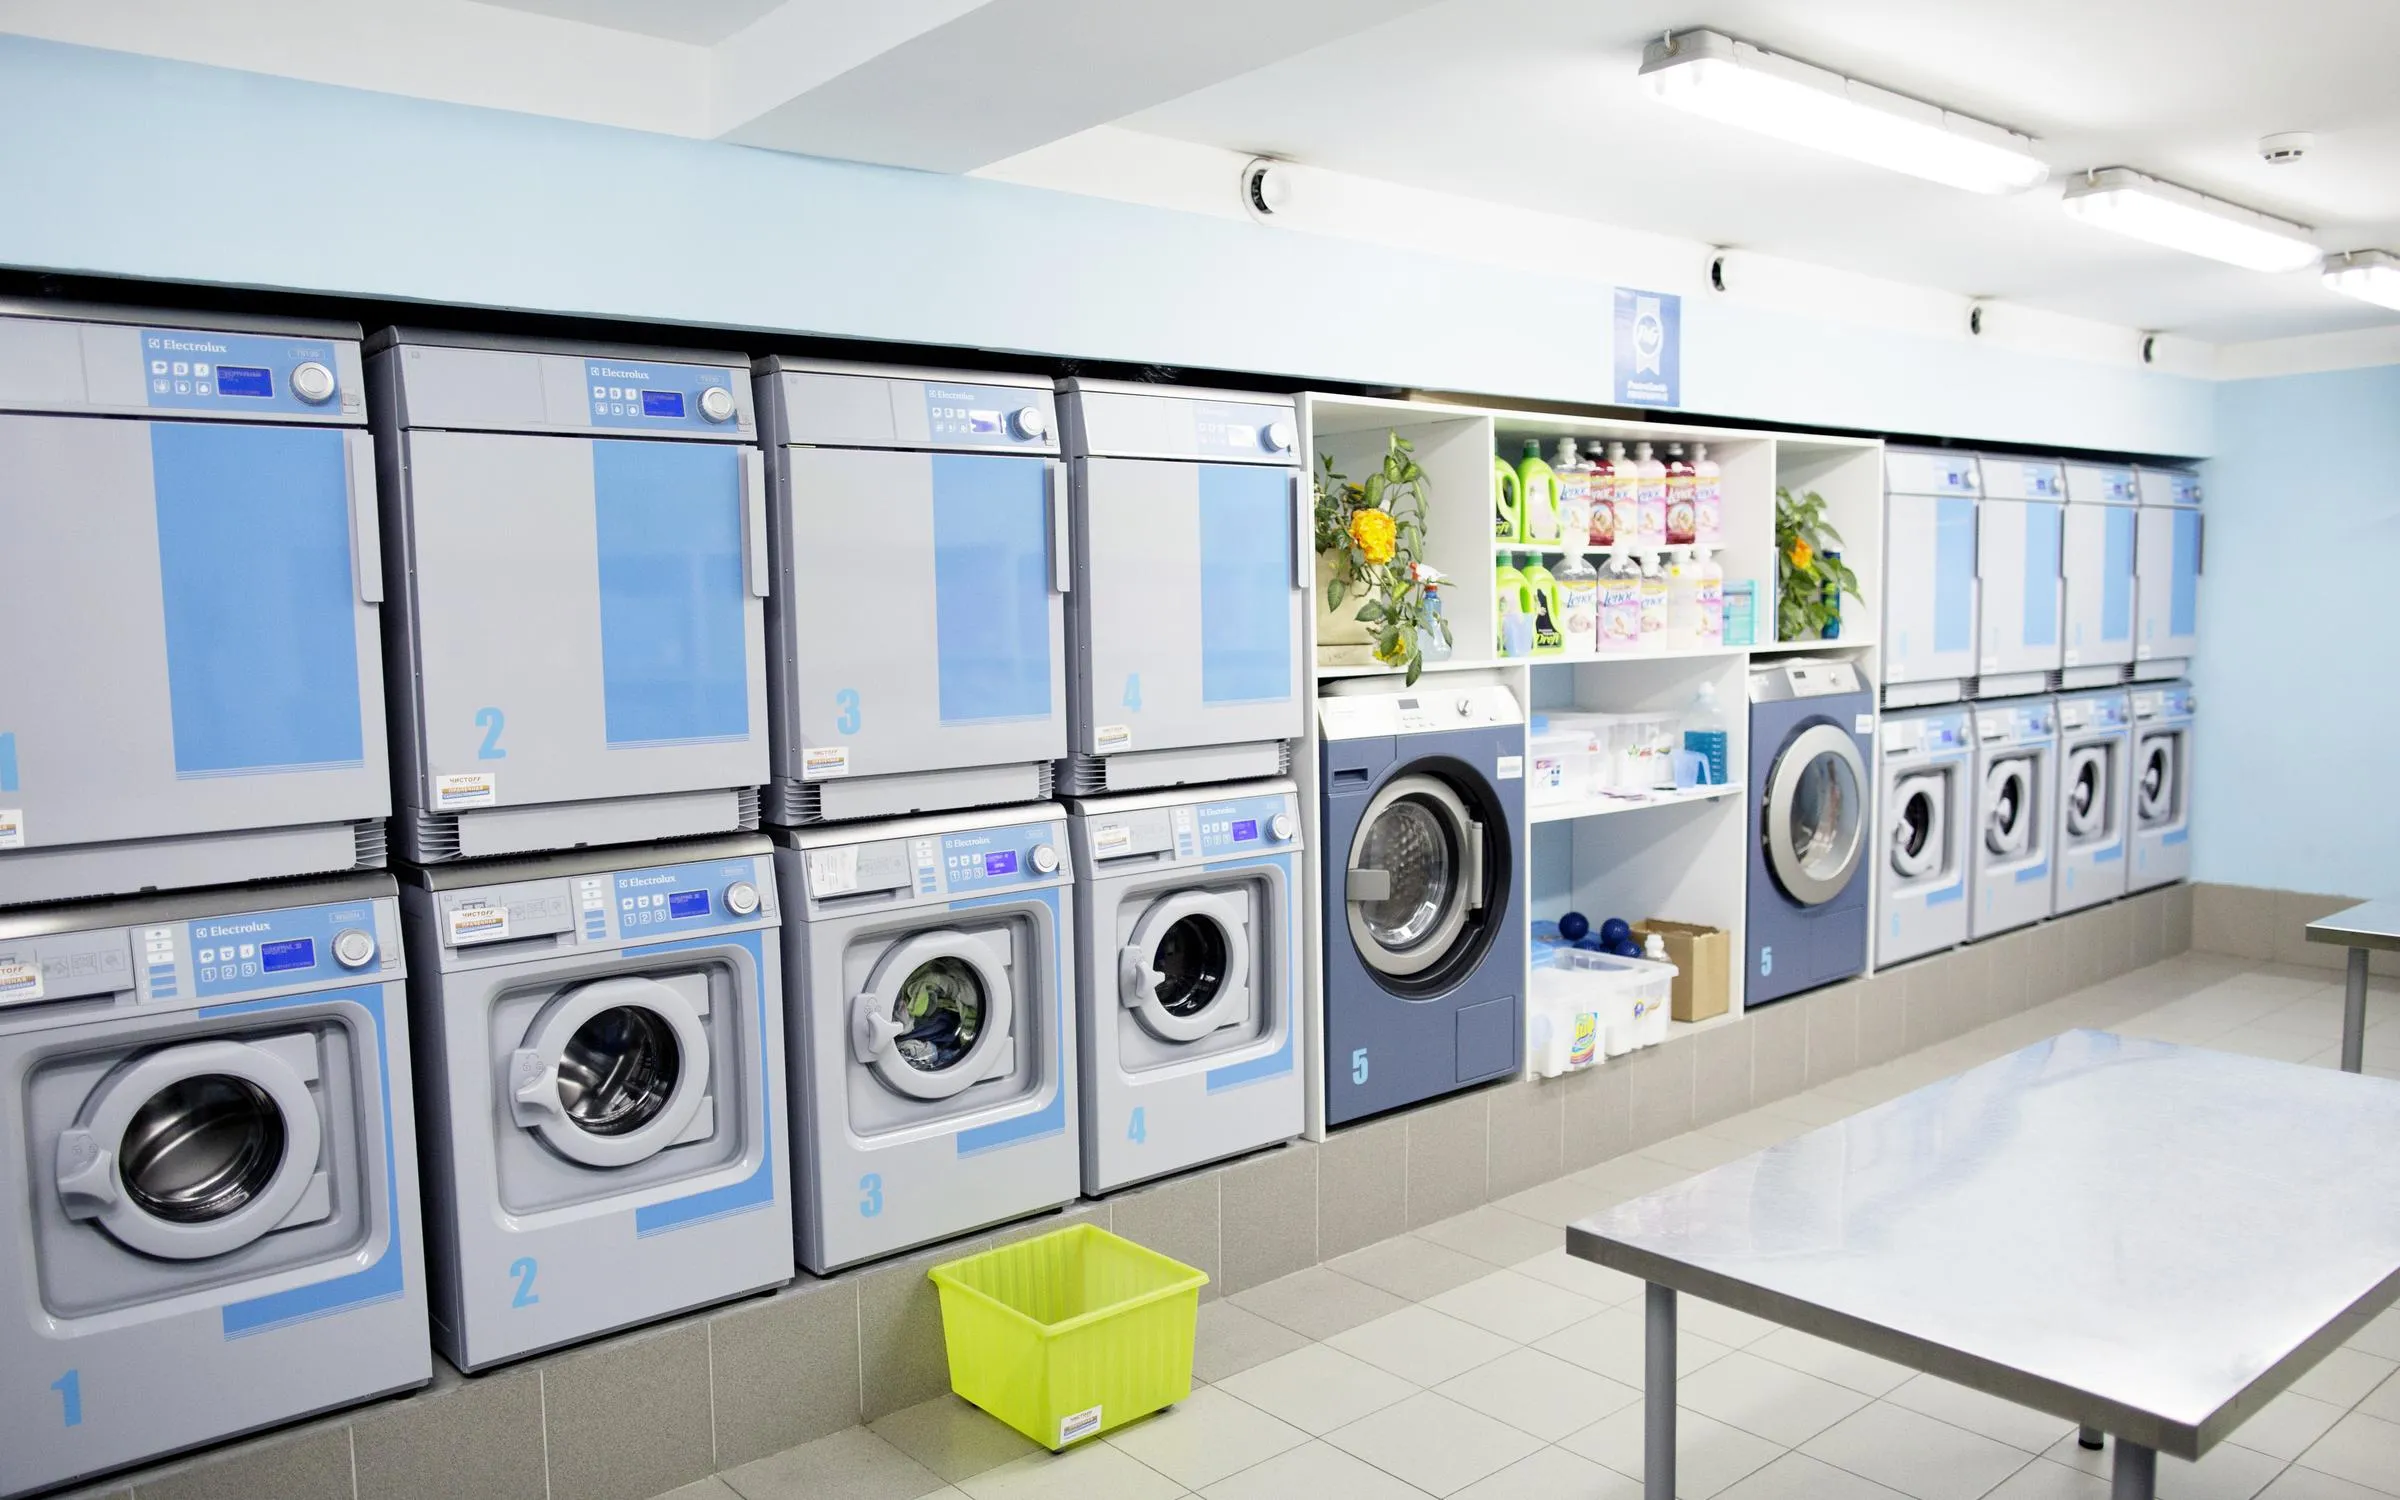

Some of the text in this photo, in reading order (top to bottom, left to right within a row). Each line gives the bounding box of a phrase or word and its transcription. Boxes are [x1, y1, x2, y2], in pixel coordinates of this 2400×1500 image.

[164, 339, 227, 353] Electrolux
[602, 369, 649, 380] Electrolux
[1123, 672, 1142, 713] 4
[836, 688, 861, 735] 3
[475, 706, 507, 760] 2
[954, 837, 991, 848] Electrolux
[630, 874, 677, 888] Electrolux
[211, 921, 271, 937] Electrolux
[627, 914, 634, 924] 1
[642, 913, 650, 923] 2
[656, 911, 664, 921] 3
[204, 970, 213, 980] 1
[225, 967, 235, 978] 2
[244, 964, 254, 975] 3
[1761, 946, 1772, 976] 5
[1352, 1048, 1369, 1085] 5
[1127, 1107, 1147, 1145] 4
[859, 1173, 883, 1218] 3
[510, 1256, 539, 1308] 2
[50, 1368, 82, 1428] 1
